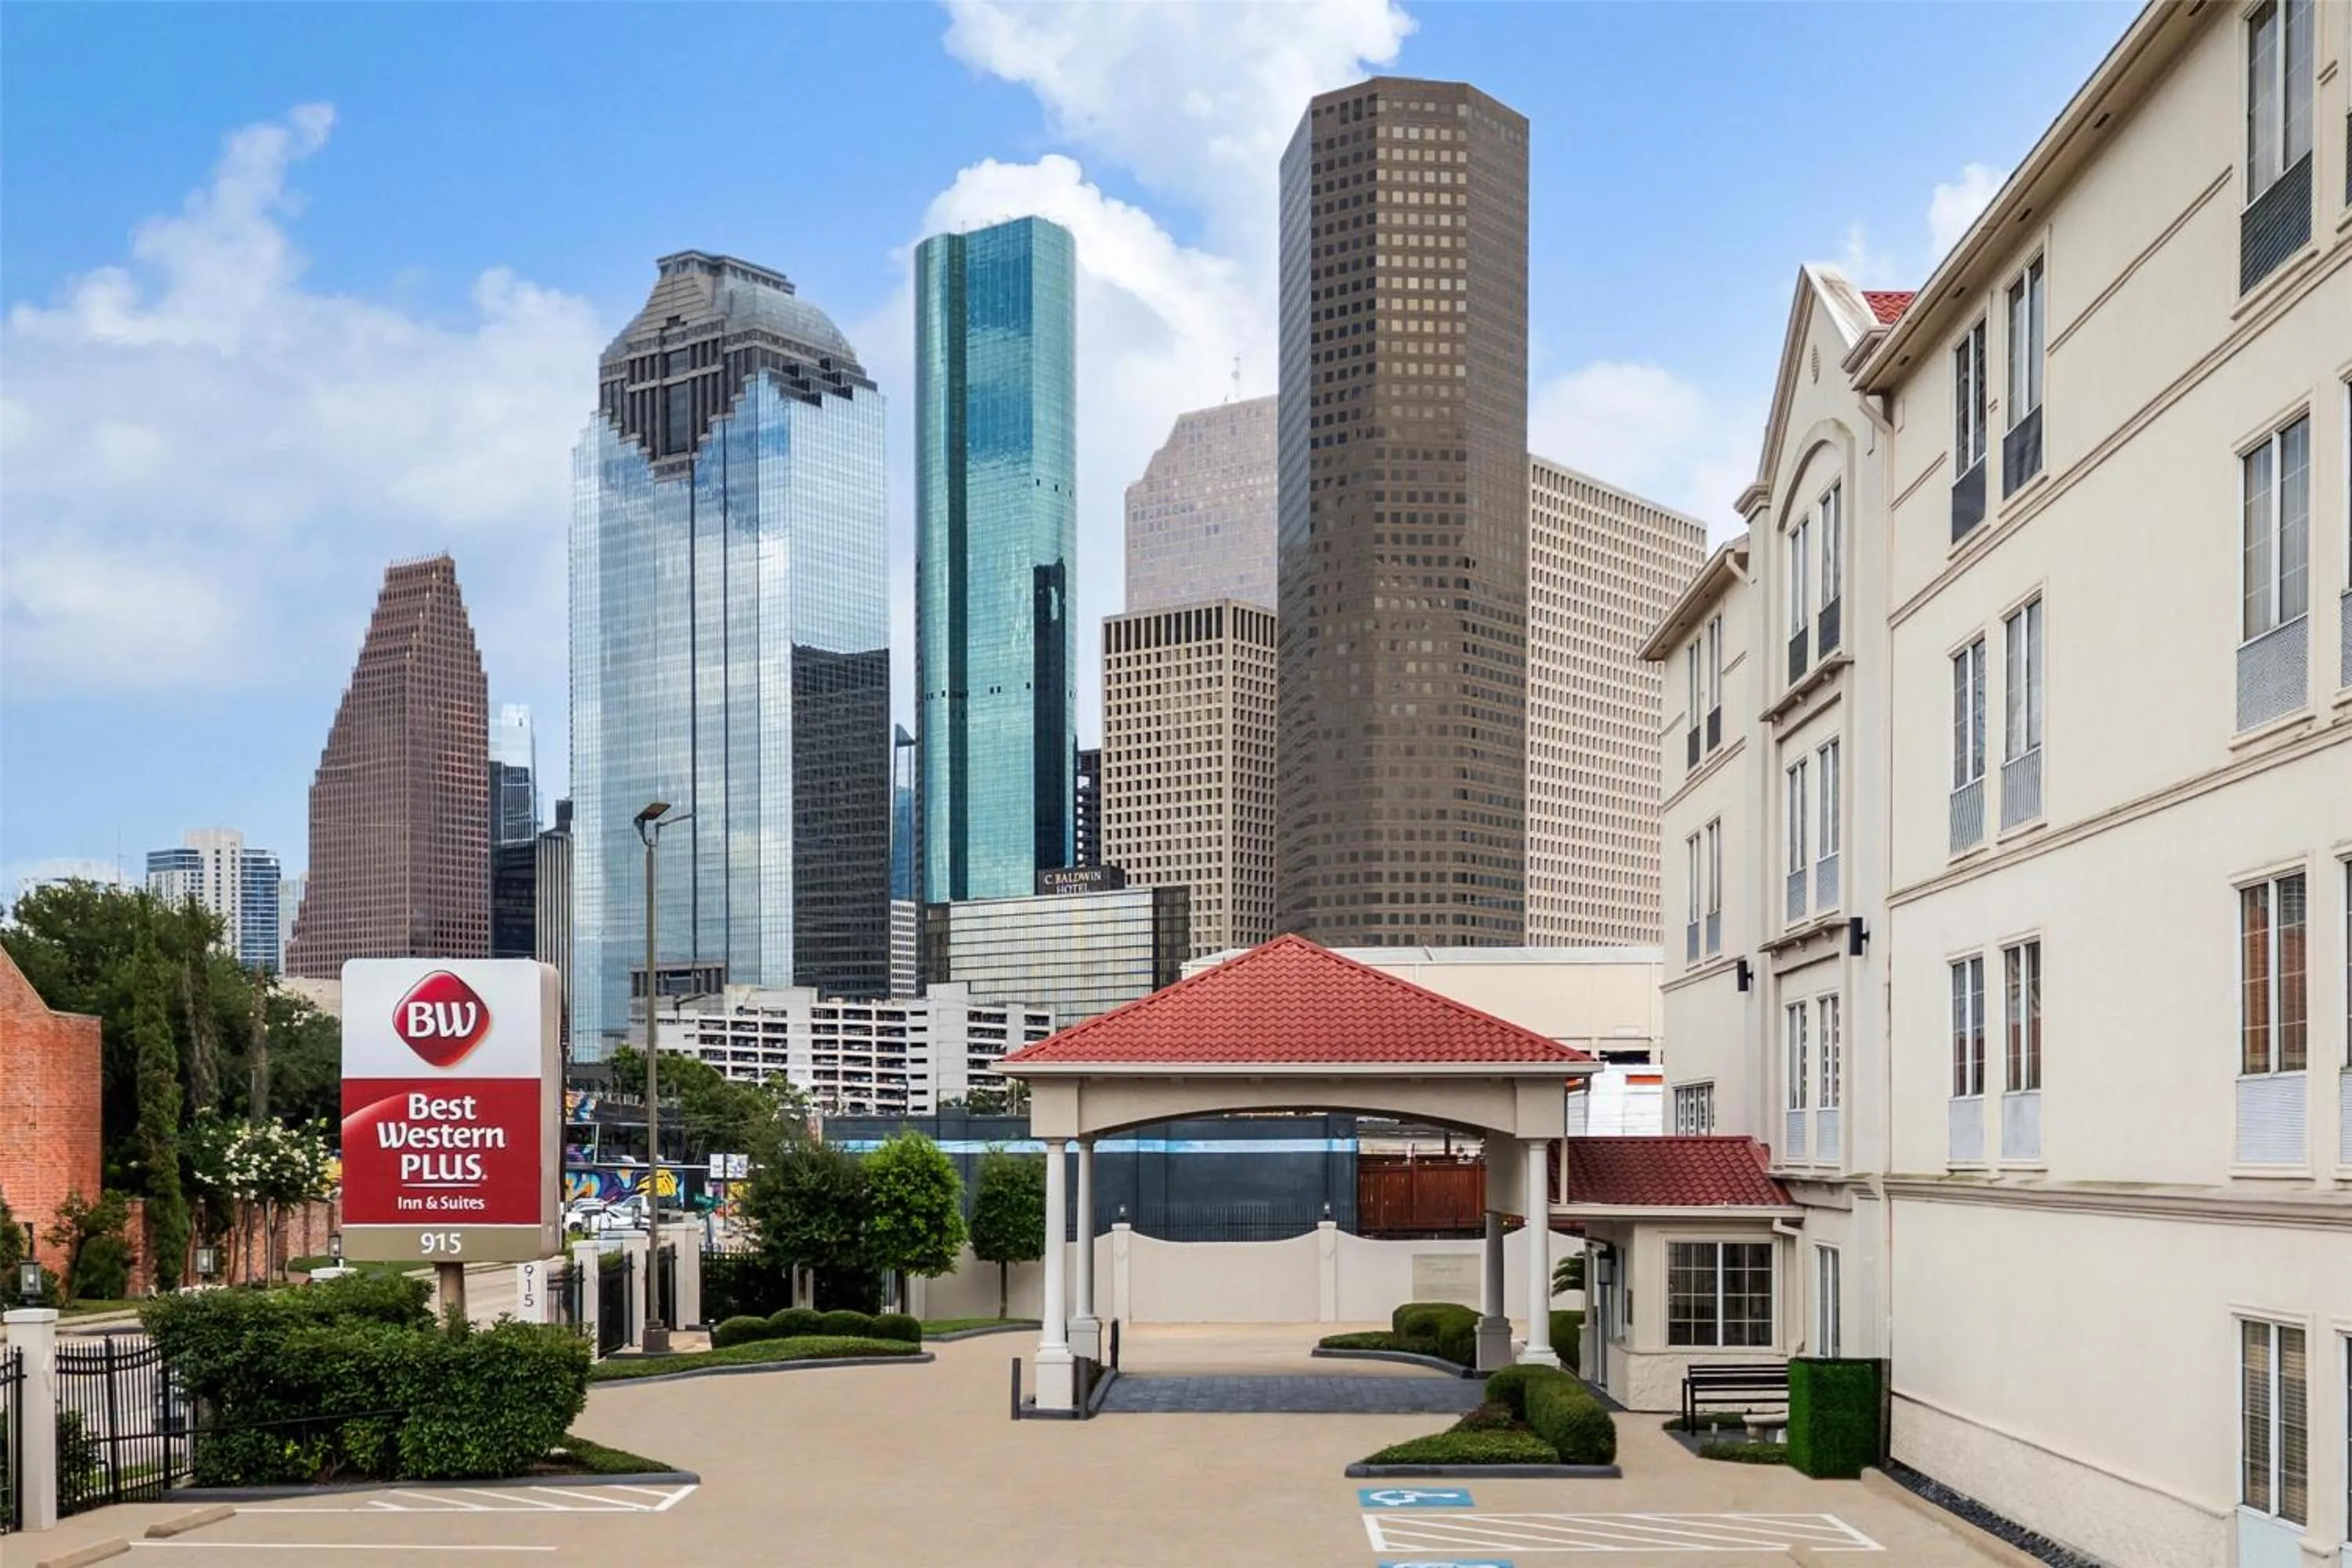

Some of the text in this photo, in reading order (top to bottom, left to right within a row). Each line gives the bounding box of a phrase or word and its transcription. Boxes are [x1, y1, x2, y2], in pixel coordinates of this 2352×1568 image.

[1044, 870, 1102, 885] C BALDWIN
[1056, 883, 1091, 895] HOTEL
[406, 1001, 477, 1038] BW
[408, 1092, 477, 1121] Best
[376, 1121, 506, 1149] Western
[401, 1153, 481, 1181] PLUS
[397, 1196, 485, 1210] Inn & Suites
[420, 1232, 462, 1254] 915
[524, 1265, 534, 1307] 915
